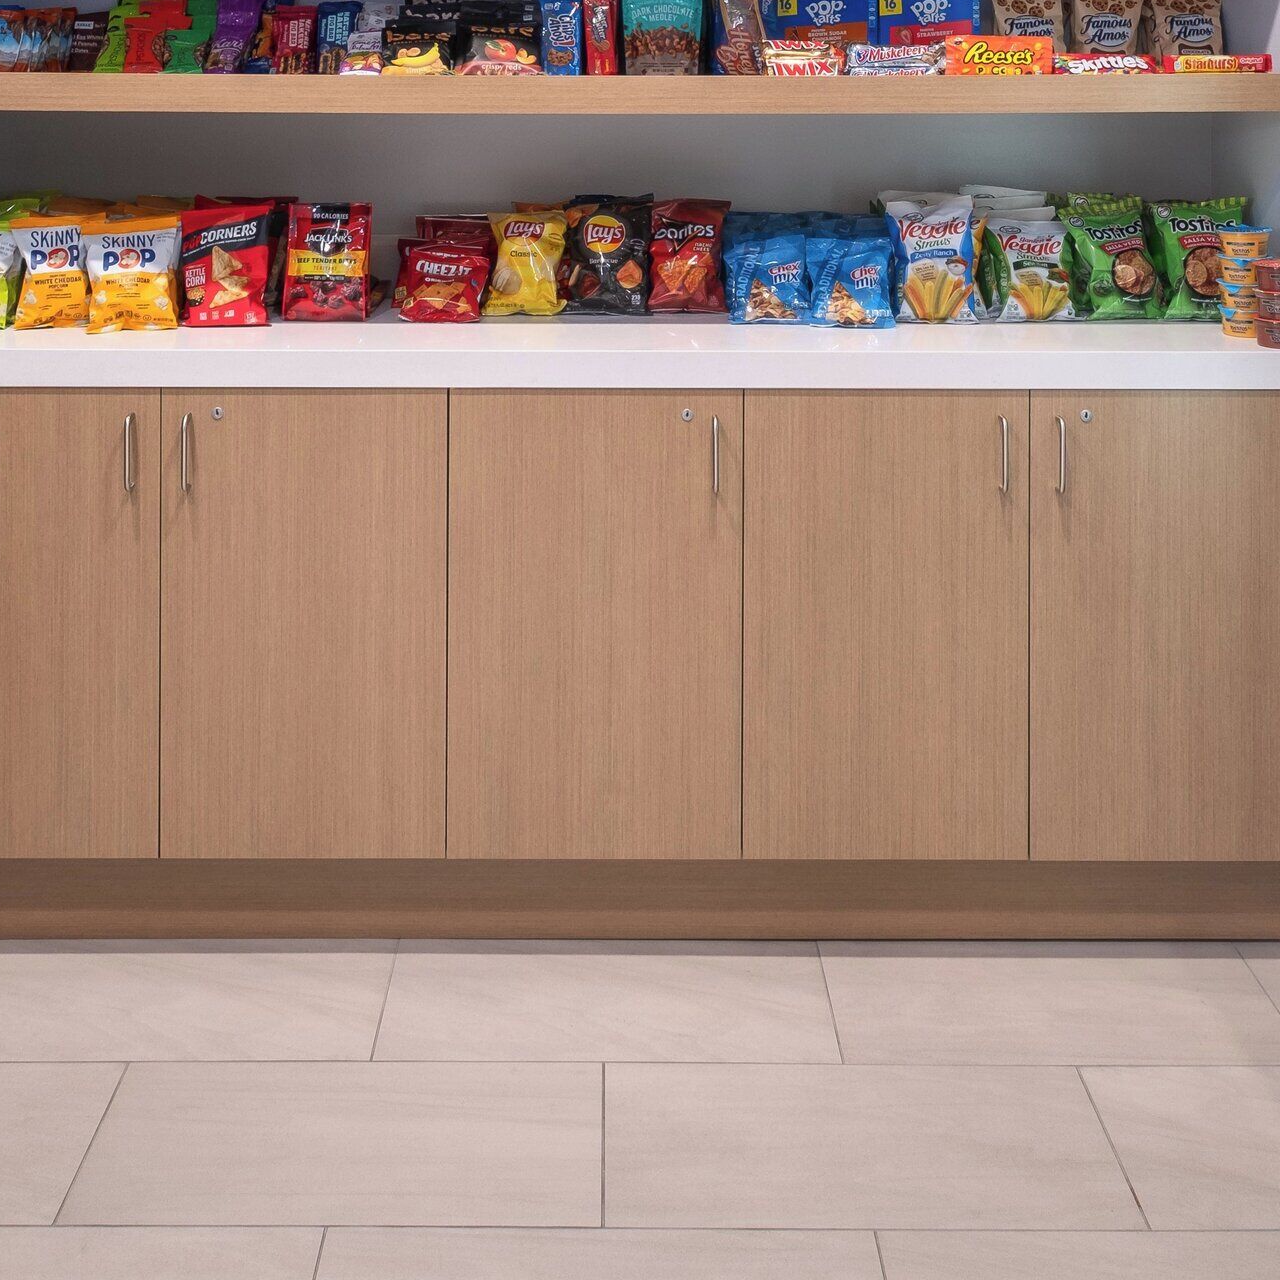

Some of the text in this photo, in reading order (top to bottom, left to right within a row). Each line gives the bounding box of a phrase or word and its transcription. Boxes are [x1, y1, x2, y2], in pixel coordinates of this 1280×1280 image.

[631, 4, 694, 21] DARK CHOCOLATE
[648, 13, 677, 22] MEDLEY
[813, 13, 841, 26] tarts
[918, 12, 946, 26] tarts
[548, 17, 575, 46] Ahoy!
[1004, 16, 1055, 36] Famous
[1078, 13, 1132, 36] Famous
[1163, 12, 1213, 34] Famous
[916, 29, 953, 38] STRAWBERRY
[1084, 28, 1130, 45] Amos
[1171, 26, 1213, 43] Amos
[869, 45, 933, 62] Musketeers
[963, 41, 1035, 65] Reese's
[772, 58, 835, 76] TWIX
[1069, 55, 1147, 74] Skittles
[1184, 56, 1264, 71] Starburst Original
[182, 221, 258, 253] POPCORNERS
[654, 223, 715, 240] Doritos
[898, 217, 966, 241] Veggie
[304, 233, 327, 243] JACK
[914, 237, 952, 251] Straws
[997, 233, 1062, 256] Veggie
[30, 247, 80, 270] POP
[102, 248, 156, 271] POP
[510, 250, 538, 258] Classic
[185, 267, 206, 277] KETTLE
[768, 261, 802, 276] Chex
[772, 270, 801, 284] mix
[850, 265, 881, 281] Chex
[185, 275, 206, 288] CORN
[854, 275, 881, 290] mix
